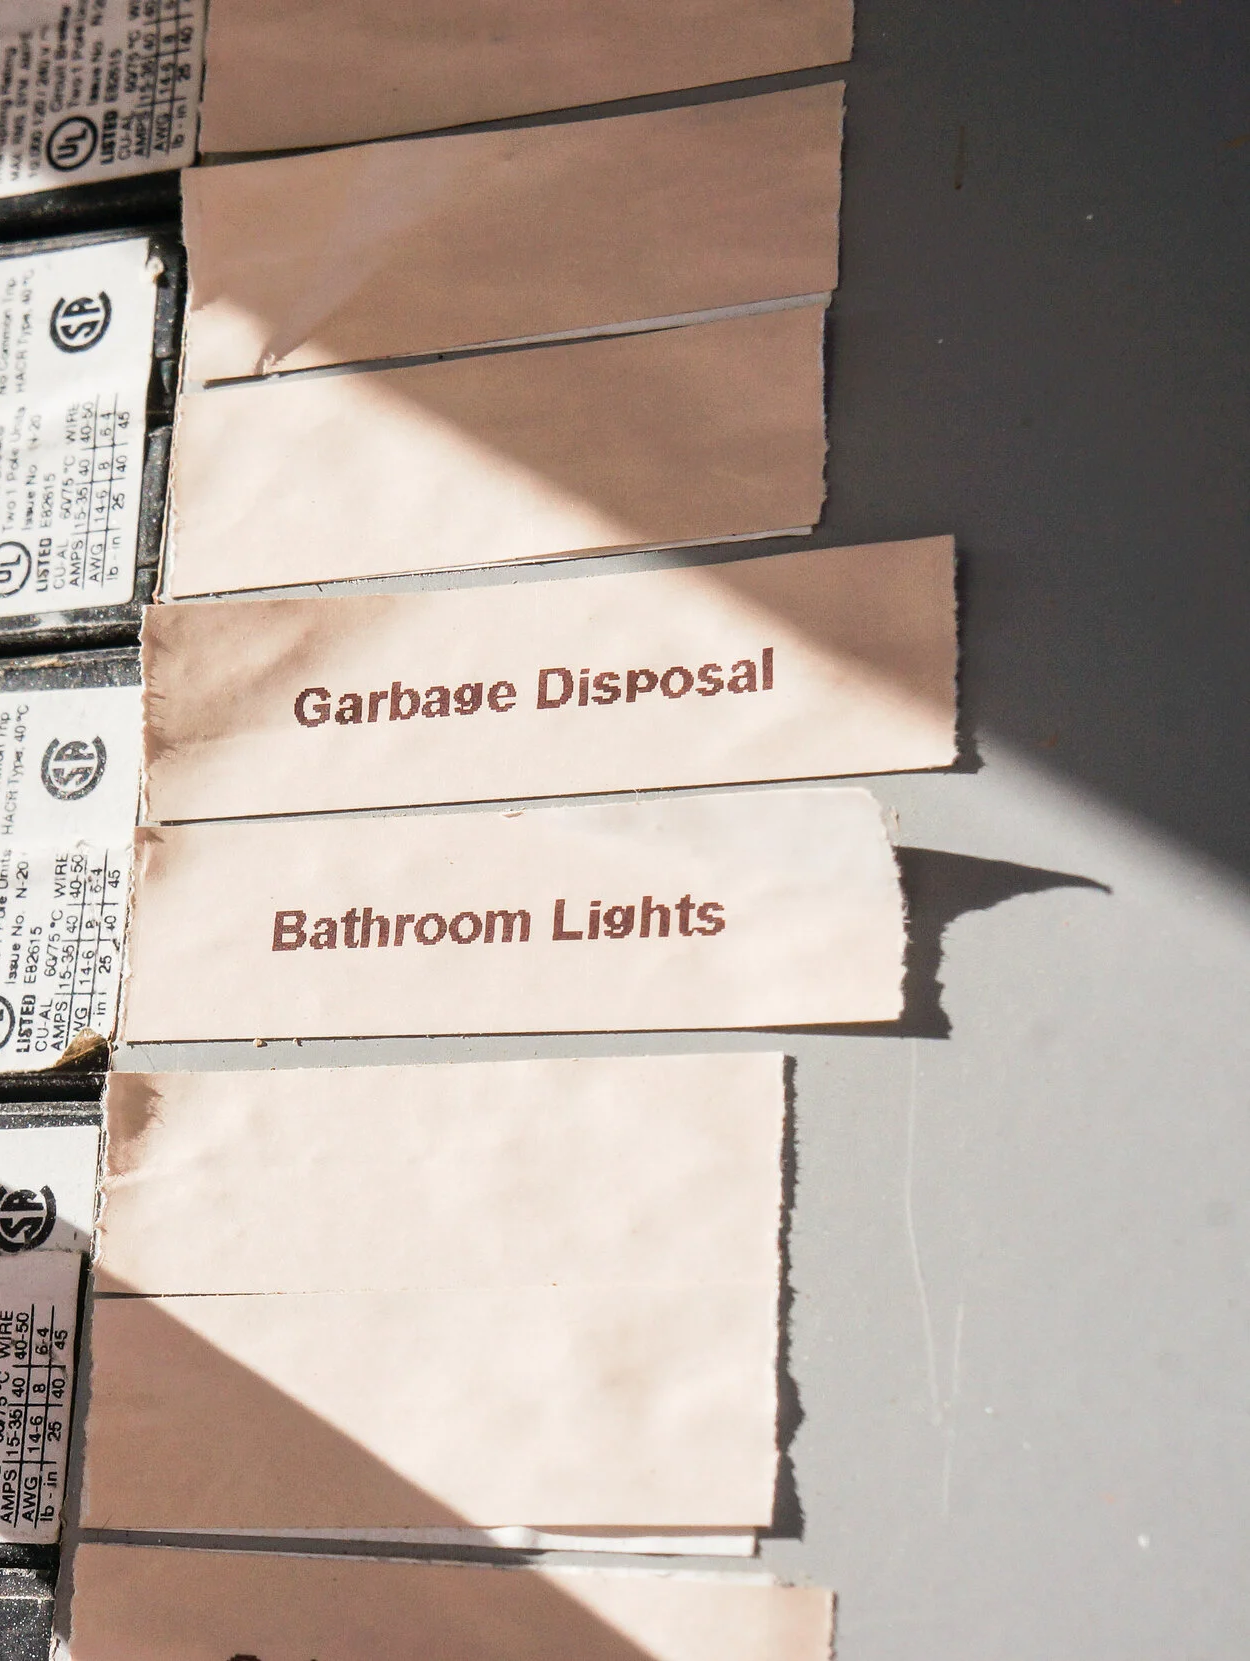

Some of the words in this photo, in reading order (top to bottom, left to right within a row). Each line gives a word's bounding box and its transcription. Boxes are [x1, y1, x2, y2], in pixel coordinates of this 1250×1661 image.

[117, 411, 129, 429] 45
[78, 458, 90, 476] 40
[97, 461, 110, 470] 8
[115, 455, 126, 472] 40
[1, 500, 16, 532] Two
[73, 486, 88, 528] 15-35
[93, 489, 107, 522] 14-6
[110, 492, 124, 510] 25
[35, 537, 52, 592] LISTED
[68, 539, 83, 586] AMPS
[88, 543, 103, 582] AWG
[293, 669, 517, 728] Garbage
[536, 647, 775, 711] Disposal
[14, 724, 26, 742] 40
[68, 854, 84, 898] 40-50
[4, 942, 21, 984] Issue
[15, 861, 28, 898] N-20
[65, 915, 78, 933] 40
[98, 954, 112, 974] 25
[107, 869, 120, 888] 45
[272, 904, 530, 952] Bathroom
[552, 893, 726, 941] Lights
[23, 926, 42, 983] E82615
[34, 998, 53, 1052] CU-AL
[53, 853, 68, 898] WIRE
[58, 944, 74, 989] 15-35
[78, 949, 94, 985] 14-6
[15, 994, 36, 1052] LISTED
[50, 1000, 68, 1051] AMPS
[72, 1007, 87, 1037] WG
[13, 1311, 29, 1360] 40-50
[34, 1327, 49, 1355] 6-4
[53, 1329, 68, 1349] 45
[11, 1377, 25, 1397] 40
[32, 1383, 46, 1393] 8
[51, 1377, 65, 1398] 40
[5, 1408, 23, 1456] 15-35
[26, 1415, 44, 1453] 14-6
[47, 1420, 62, 1442] 25
[0, 1469, 17, 1523] AMPS
[43, 1471, 57, 1487] in
[21, 1476, 38, 1522] AWG
[40, 1505, 54, 1522] lb
